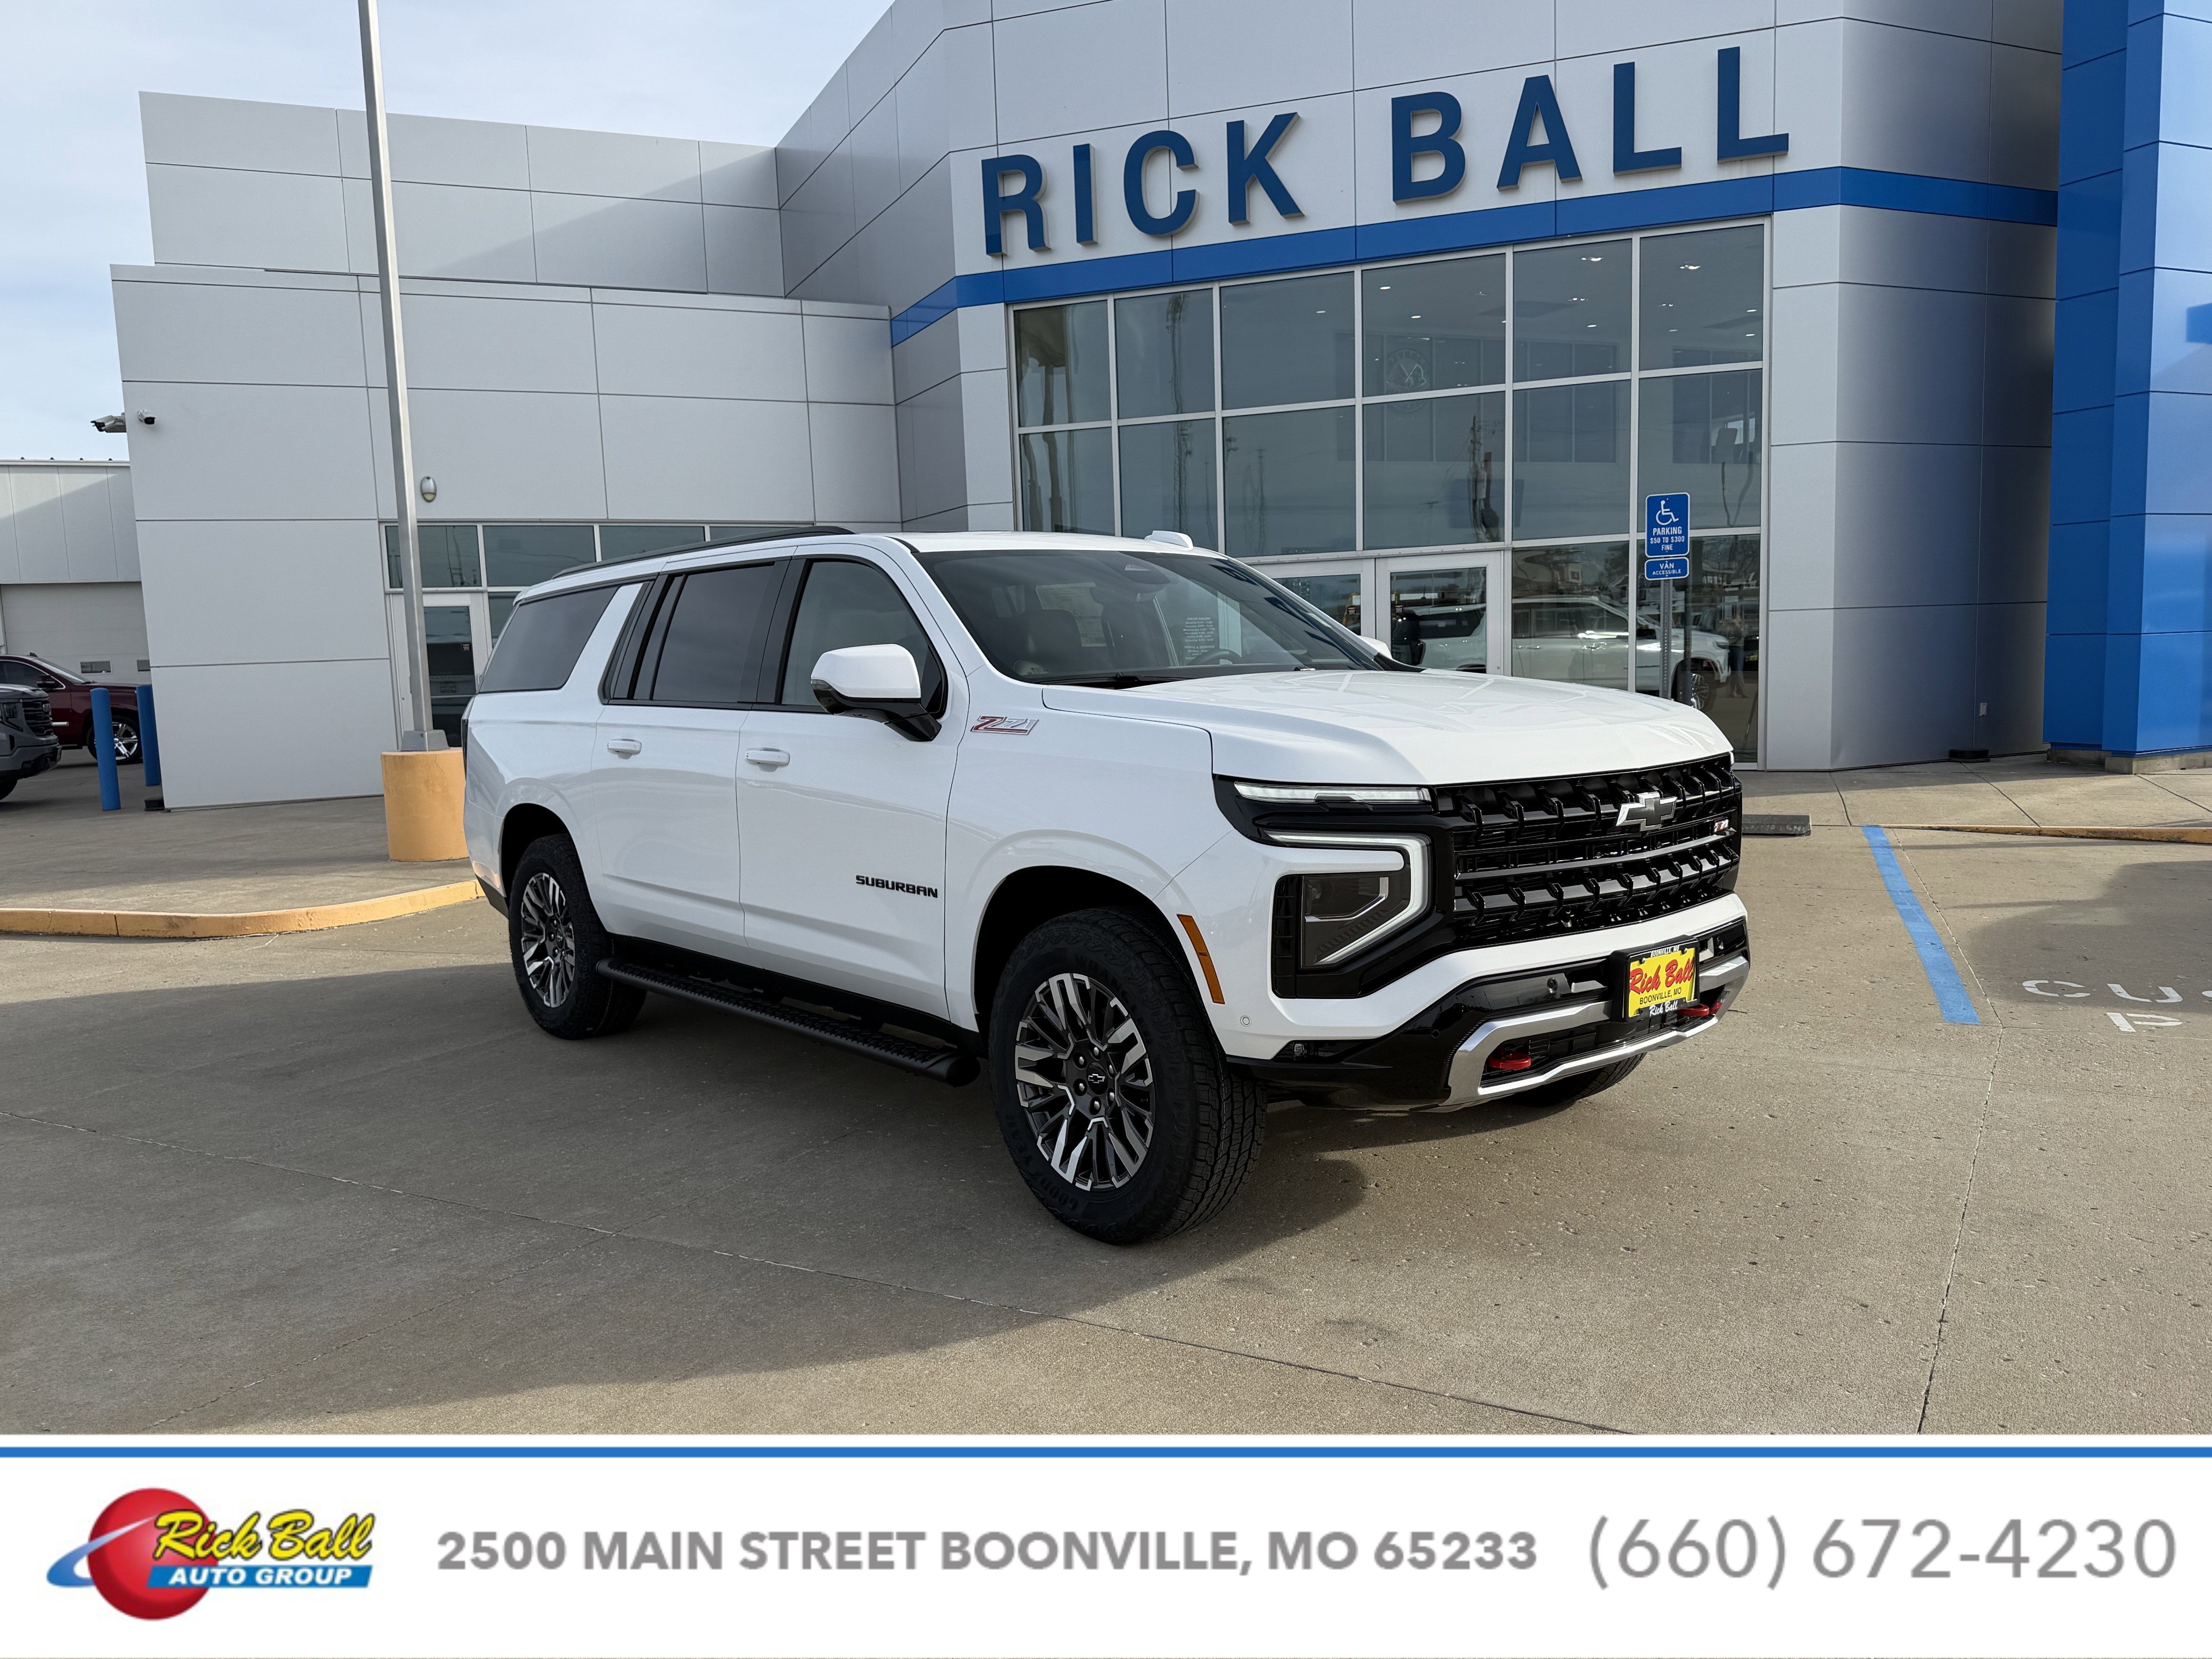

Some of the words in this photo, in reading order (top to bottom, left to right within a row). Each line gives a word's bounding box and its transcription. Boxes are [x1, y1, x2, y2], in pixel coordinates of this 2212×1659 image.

[981, 112, 1304, 256] RICK
[1392, 46, 1789, 204] BALL
[1653, 526, 1682, 536] PARKING
[970, 715, 1039, 735] Z71
[856, 875, 938, 898] SUBURBAN
[1630, 964, 1661, 994] Rick
[1665, 956, 1695, 988] Ball
[1640, 990, 1673, 1005] BOONVILLE,
[1674, 987, 1682, 996] MO
[2022, 980, 2212, 1003] CU
[1649, 1003, 1664, 1017] Rick
[1664, 1000, 1678, 1012] Ball
